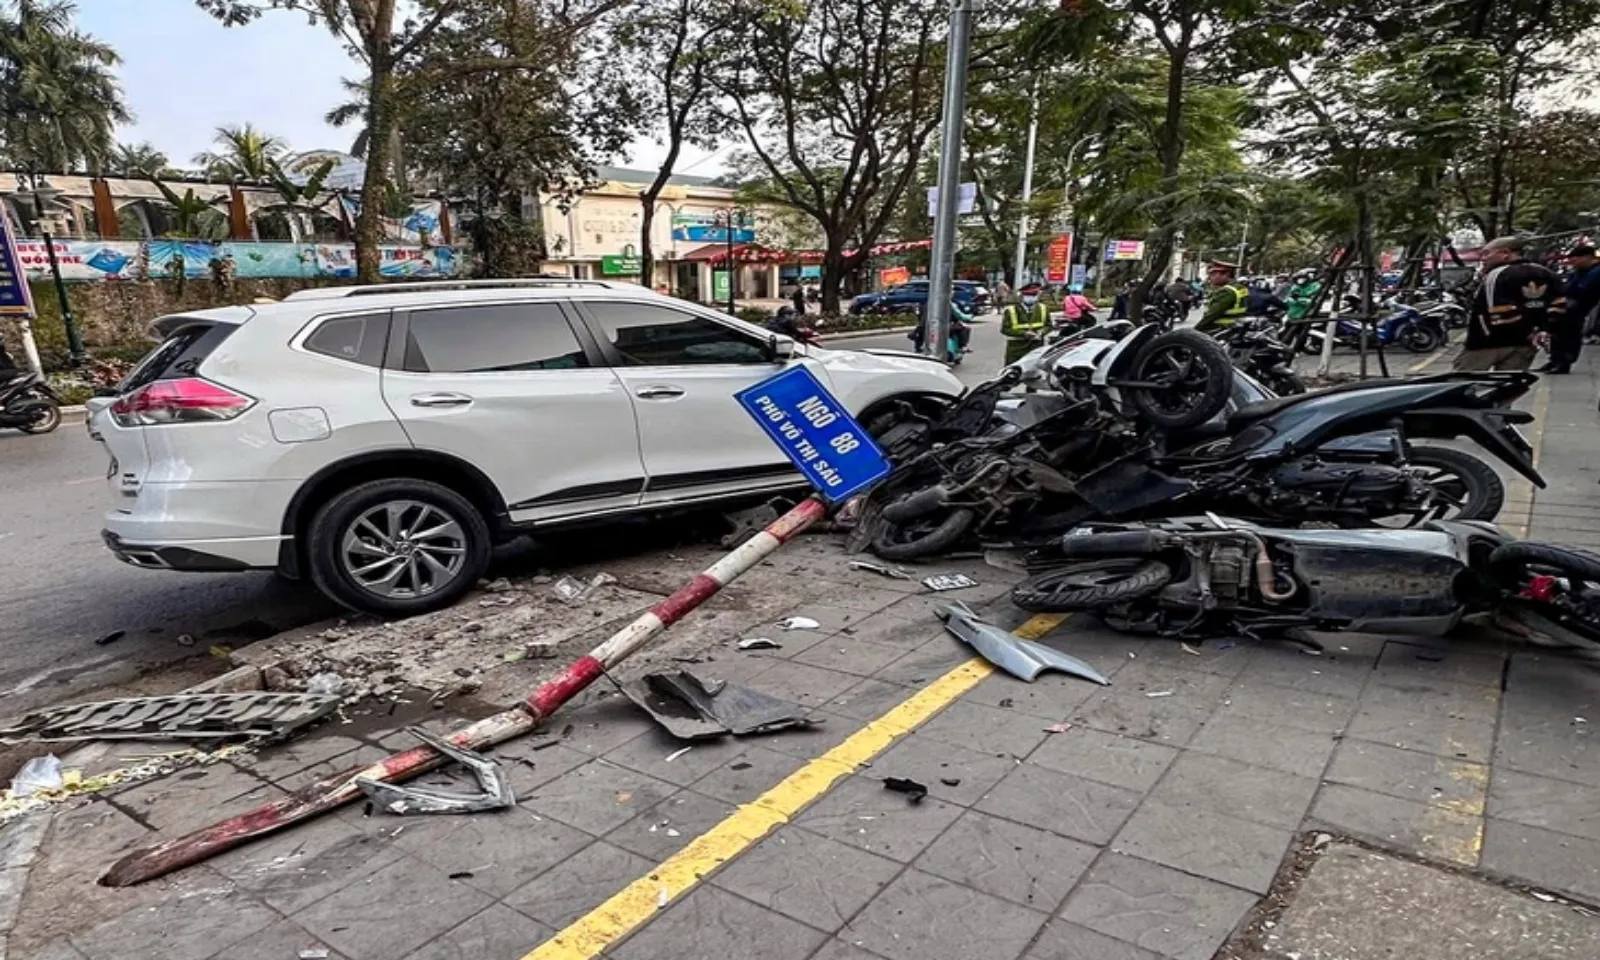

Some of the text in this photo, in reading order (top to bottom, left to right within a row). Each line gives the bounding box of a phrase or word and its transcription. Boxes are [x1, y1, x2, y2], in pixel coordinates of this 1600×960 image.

[755, 395, 843, 487] PHỐ VÕ THỊ SÁU
[796, 395, 860, 454] NGÕ 88
